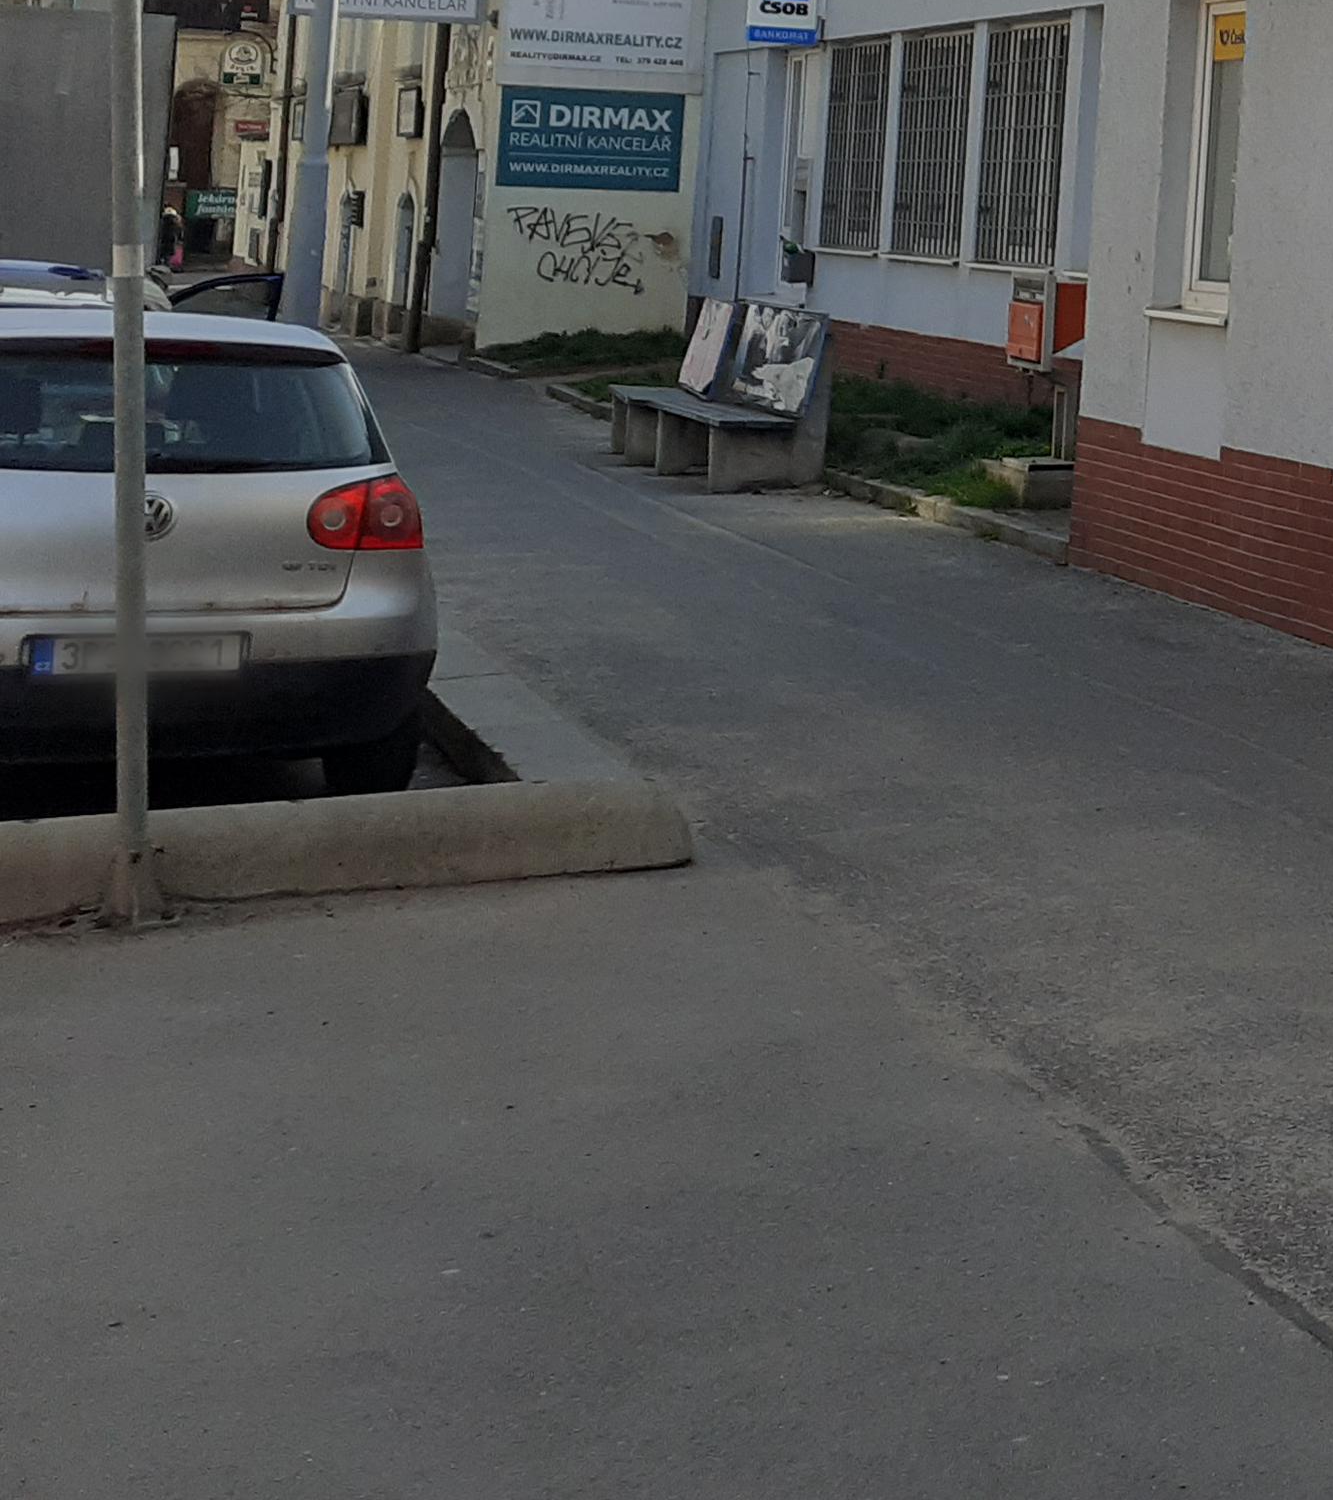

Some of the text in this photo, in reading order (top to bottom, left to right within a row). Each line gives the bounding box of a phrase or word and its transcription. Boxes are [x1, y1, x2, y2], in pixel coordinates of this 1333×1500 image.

[759, 0, 809, 15] ČSOB
[510, 27, 683, 49] WWW.DIRMAXREALITY.CZ
[549, 104, 672, 132] DIRMAX
[509, 131, 672, 152] REALITNÍ KANCELÁŘ
[509, 161, 670, 178] WWW.DIRMAXREALITY.CZ
